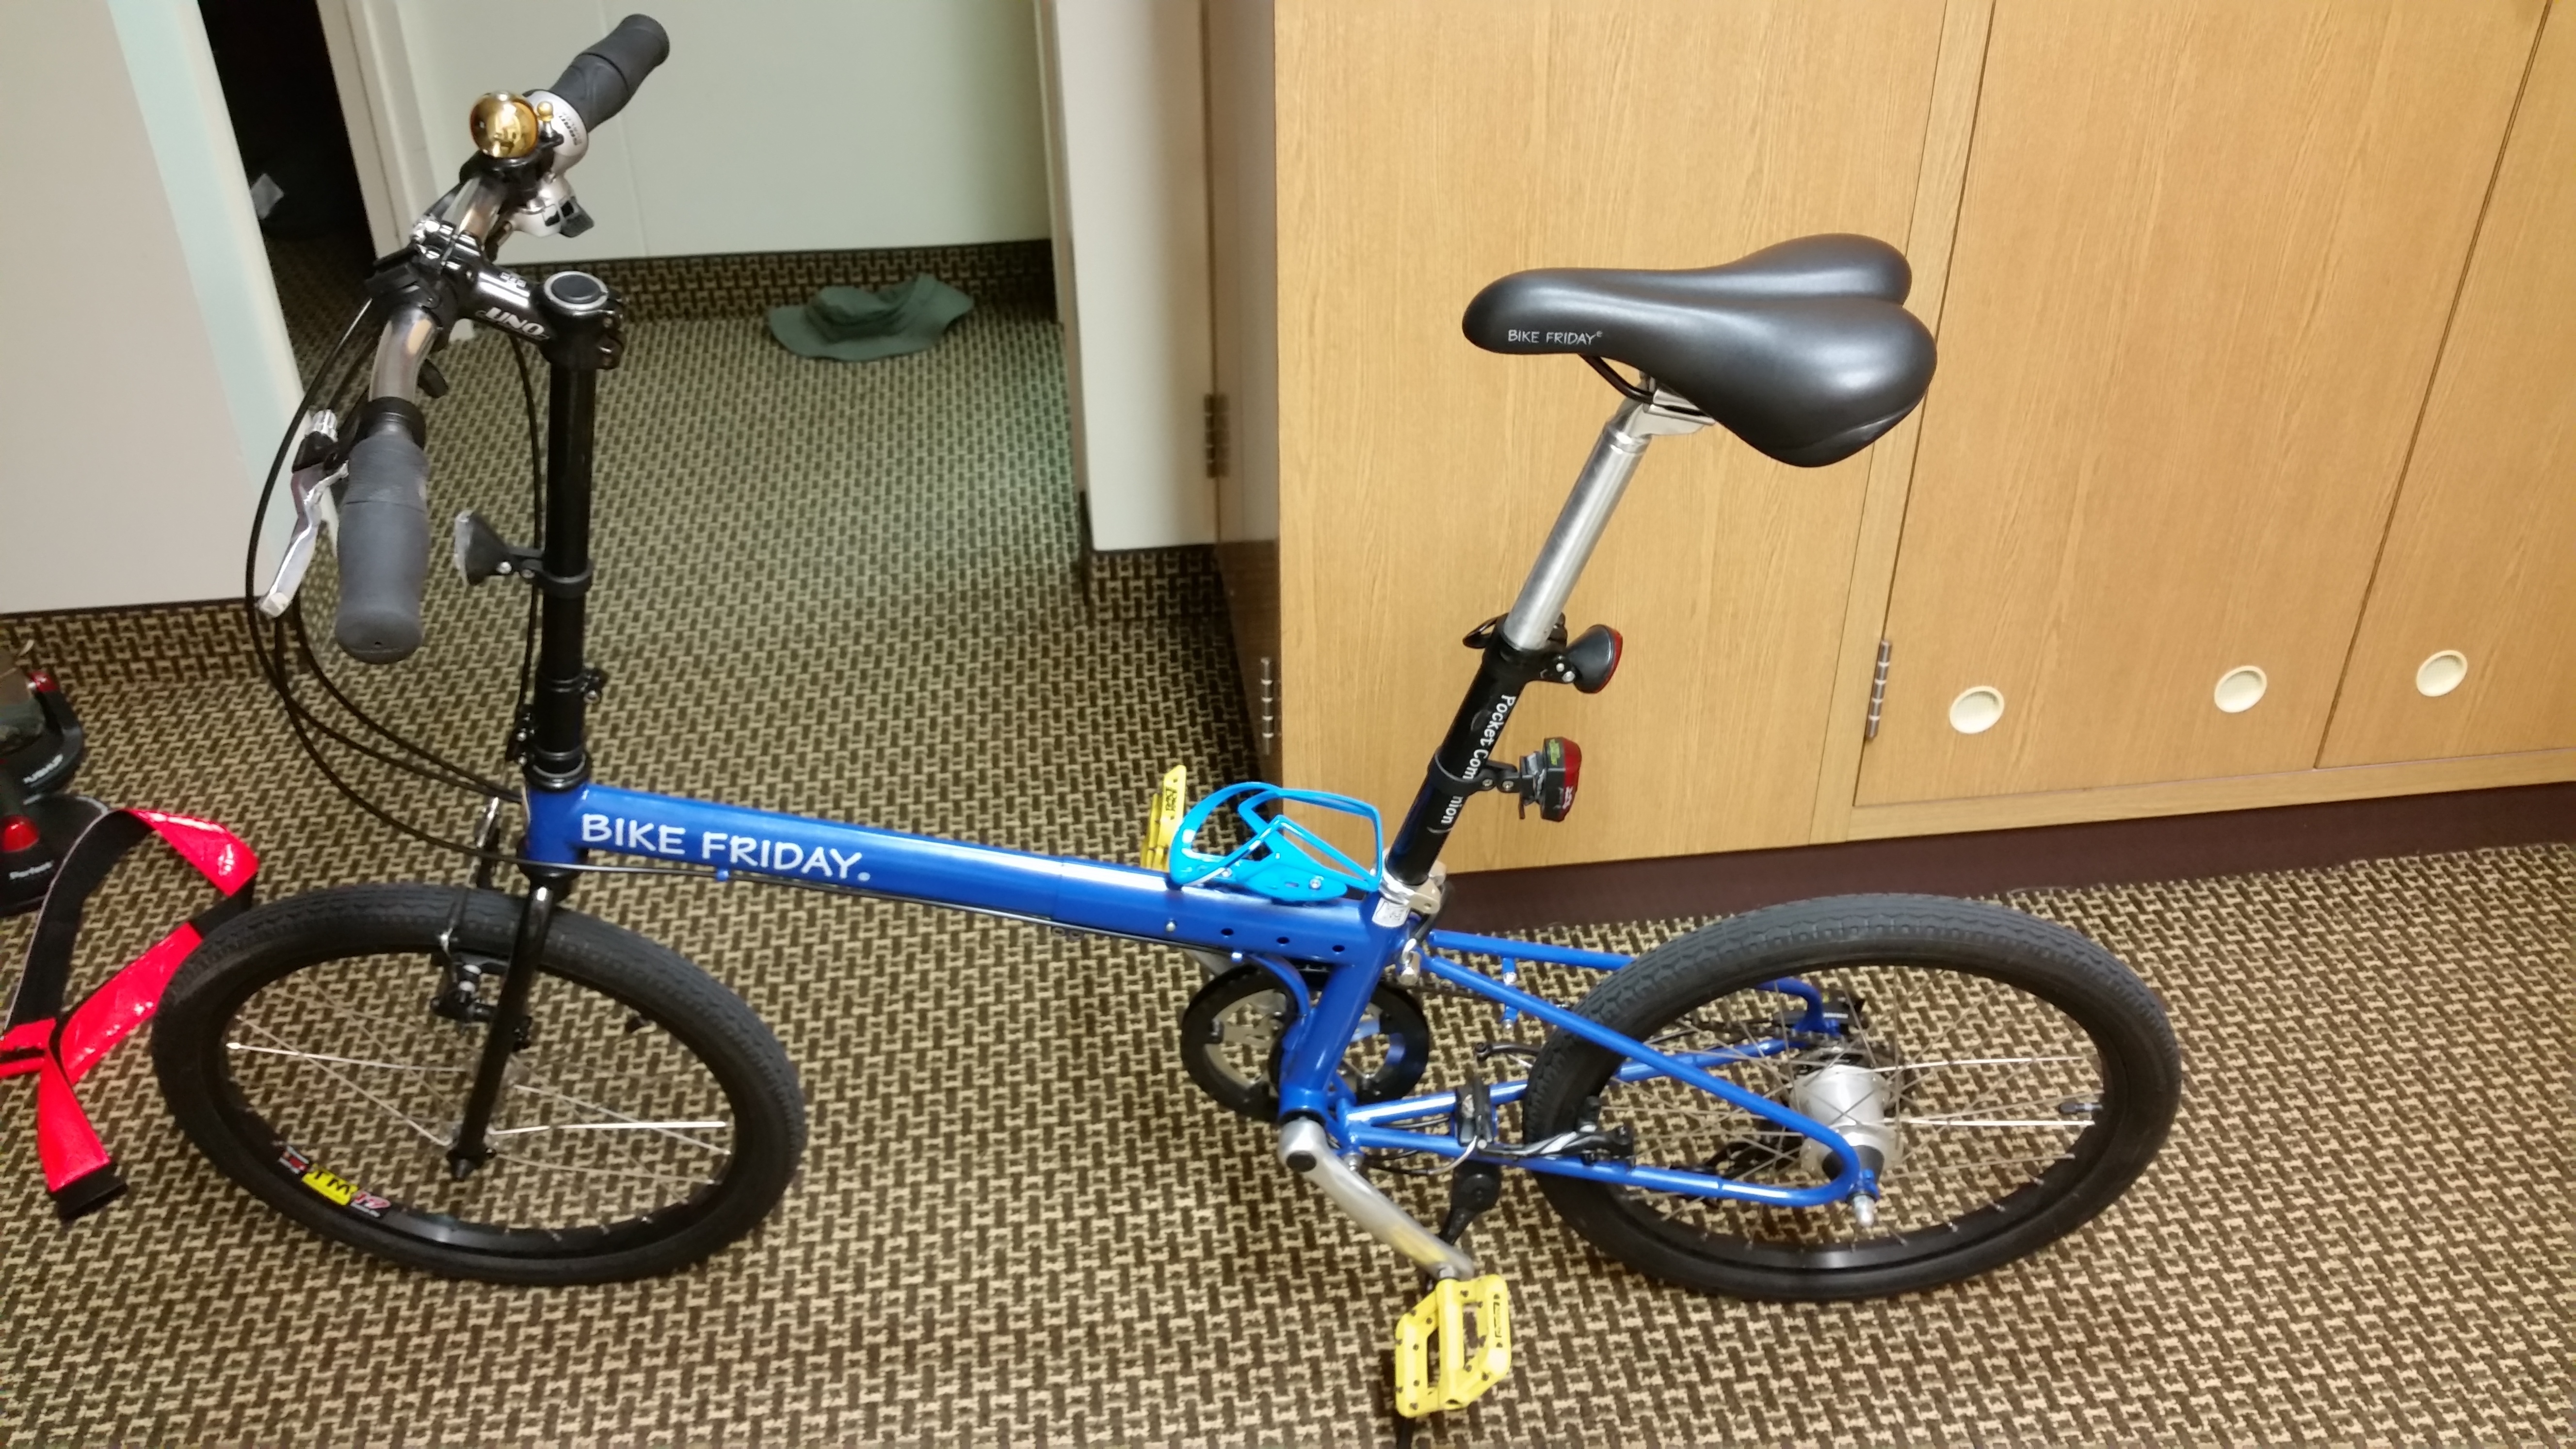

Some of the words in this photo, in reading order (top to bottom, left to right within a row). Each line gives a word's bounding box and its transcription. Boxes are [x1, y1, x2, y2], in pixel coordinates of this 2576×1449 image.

[485, 306, 545, 336] UNO
[1508, 329, 1540, 343] BIKE
[1480, 694, 1516, 746] Pocket
[581, 813, 686, 855] BIKE
